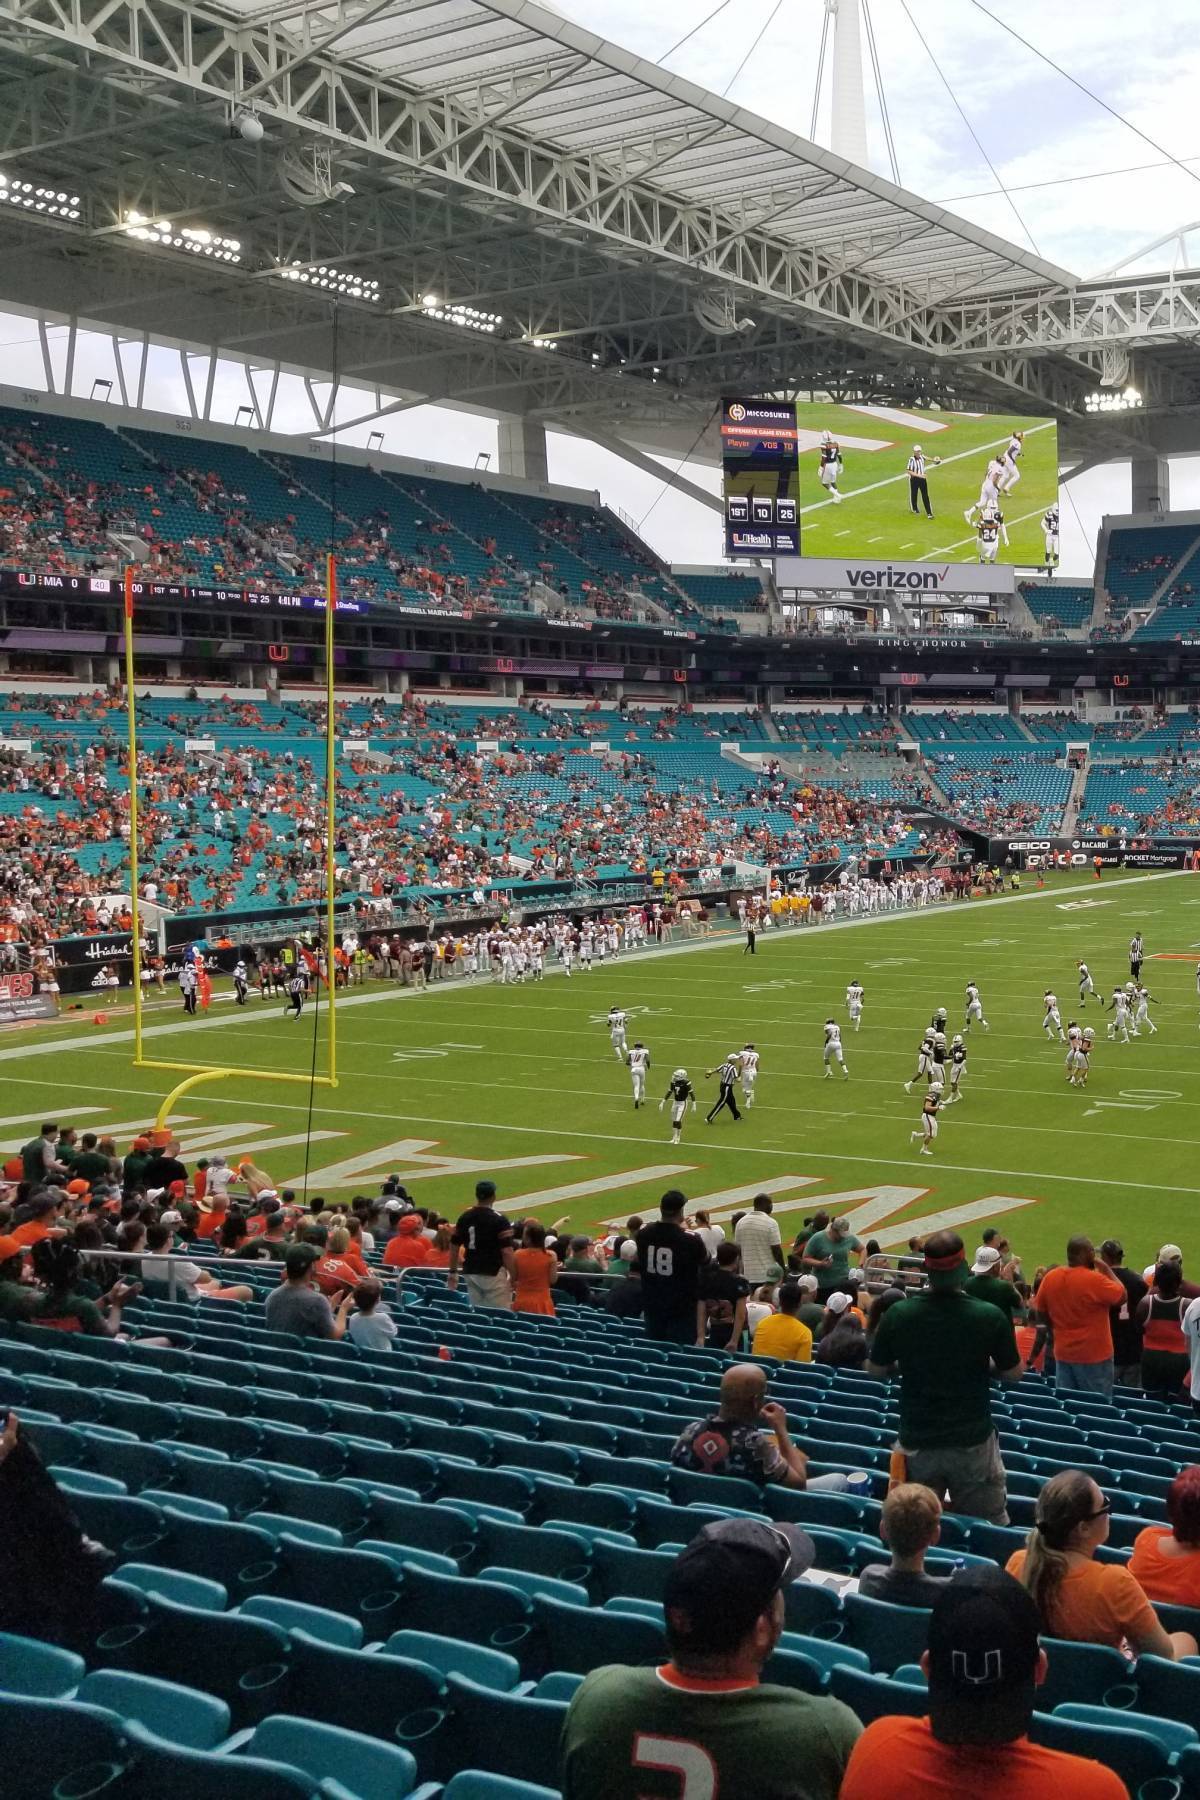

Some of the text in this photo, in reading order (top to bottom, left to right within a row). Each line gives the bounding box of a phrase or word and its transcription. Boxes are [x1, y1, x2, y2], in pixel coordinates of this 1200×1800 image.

[727, 439, 749, 447] Player
[731, 508, 746, 516] 1ST
[757, 508, 768, 518] 10
[780, 509, 793, 519] 25
[44, 576, 78, 588] MIA 0
[846, 565, 938, 589] verizon
[153, 586, 165, 594] 1ST
[216, 591, 226, 600] 10
[260, 595, 270, 604] 25
[878, 639, 900, 647] RING
[922, 639, 967, 648] HONOR
[1008, 841, 1050, 850] GEICO
[1081, 839, 1109, 849] BACARDÍ
[85, 942, 133, 959] Hialeah
[1093, 1089, 1184, 1111] 10
[467, 1225, 476, 1251] 1
[646, 1244, 673, 1277] 18
[951, 1649, 1002, 1685] U
